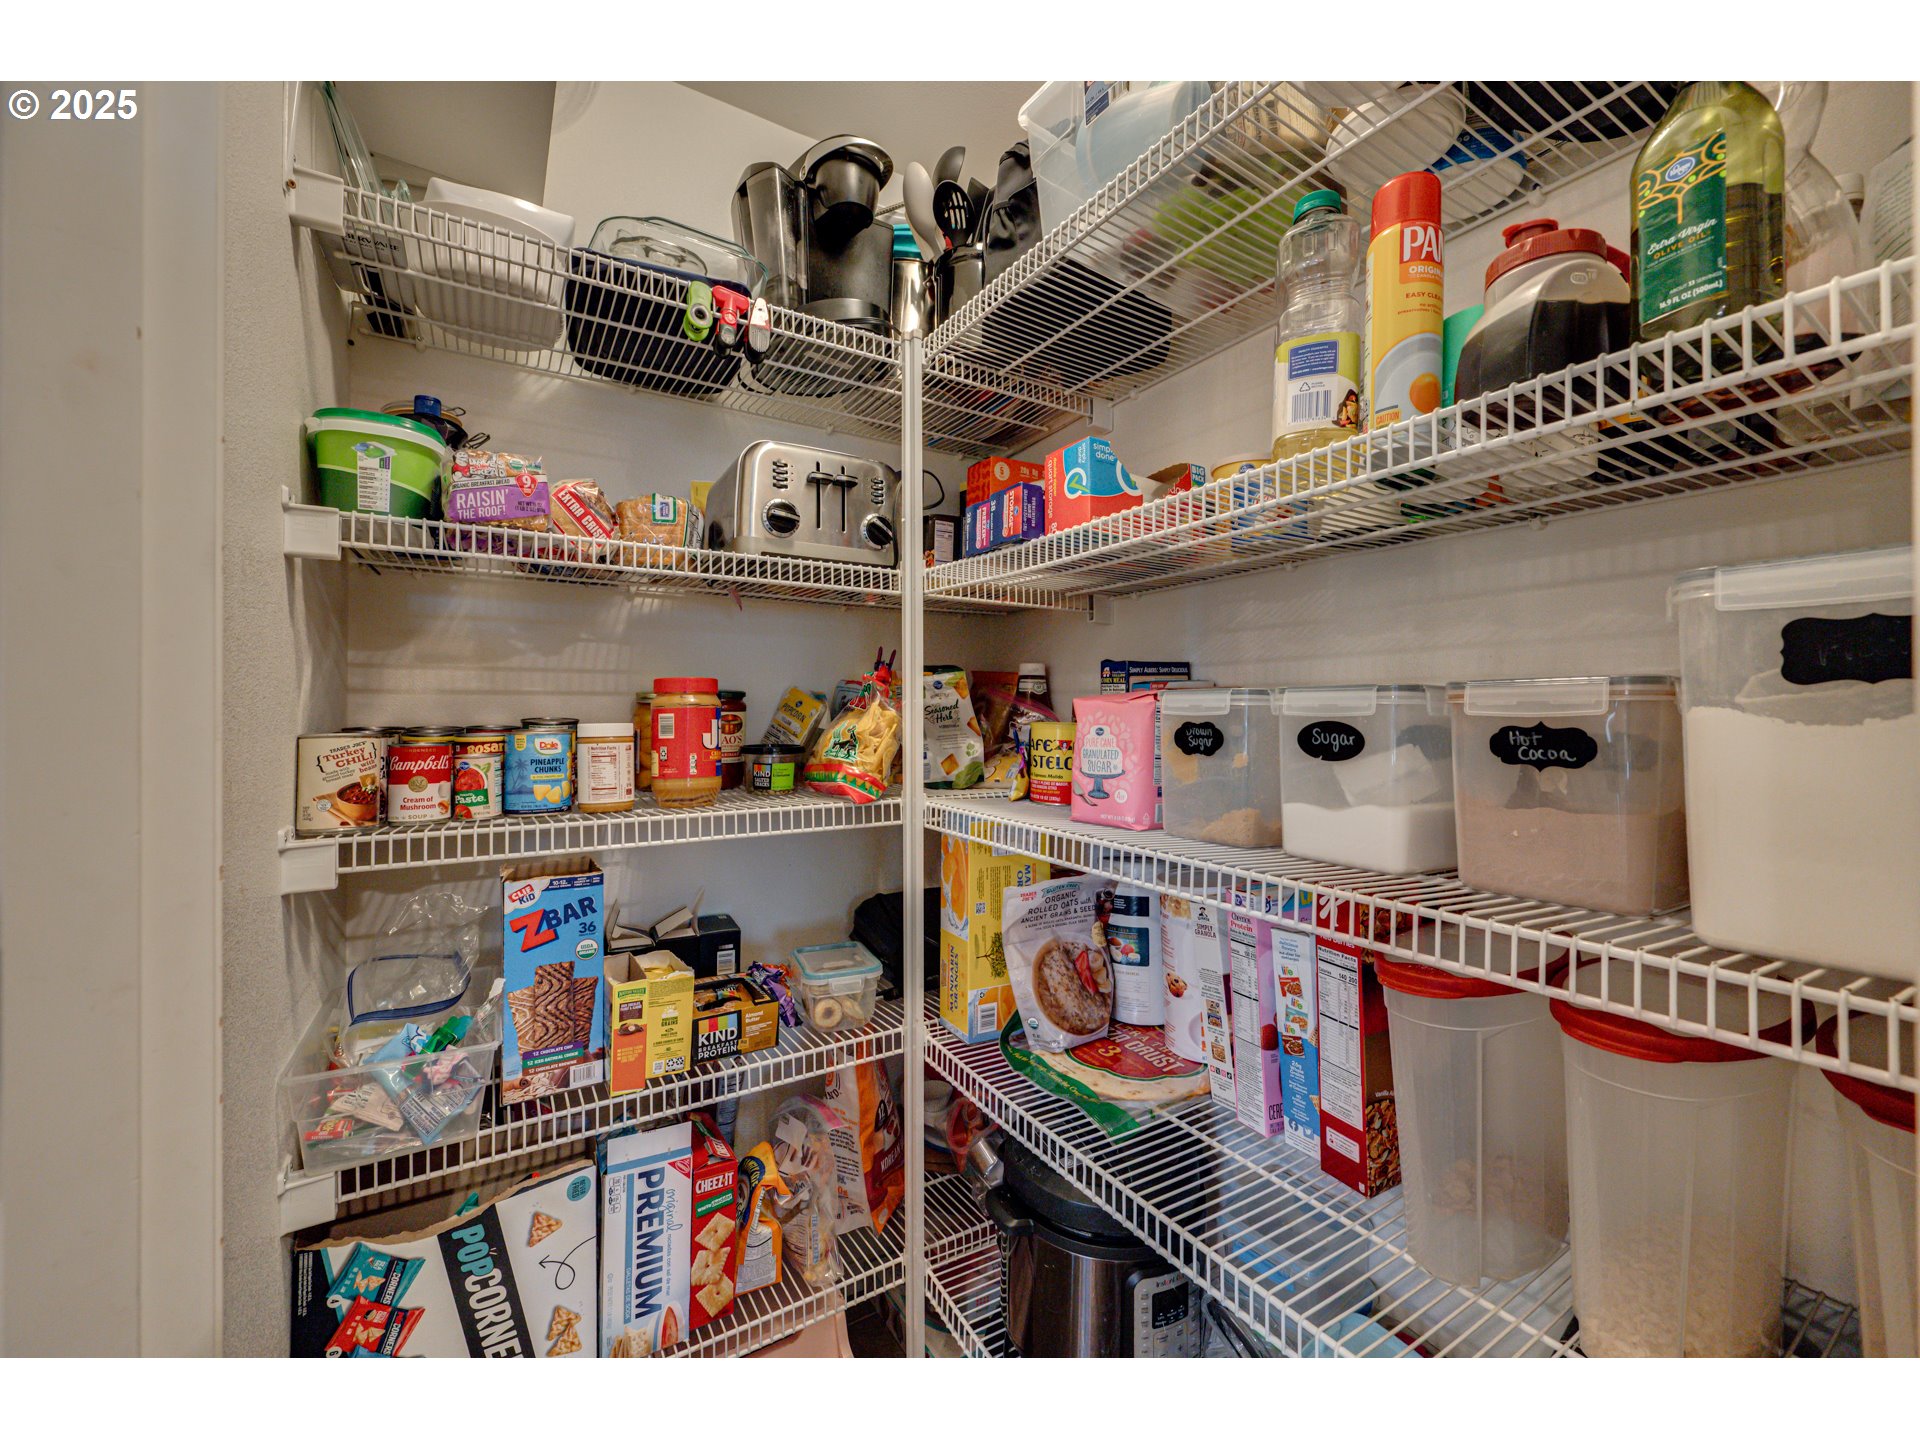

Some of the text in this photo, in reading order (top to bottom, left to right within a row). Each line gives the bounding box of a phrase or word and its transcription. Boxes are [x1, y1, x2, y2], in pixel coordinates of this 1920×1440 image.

[1647, 236, 1677, 255] Extra
[1677, 218, 1718, 239] Virgin
[1653, 241, 1684, 260] OLIVE
[1408, 265, 1443, 276] ORIGIN
[1405, 291, 1426, 299] EASY
[1672, 295, 1681, 304] FL
[1681, 290, 1692, 300] OZ
[1375, 410, 1400, 425] CAUTION
[1095, 451, 1115, 462] done
[1191, 464, 1205, 475] BIG
[470, 479, 495, 488] BREAKFAST
[495, 478, 511, 486] BREAD
[1191, 473, 1205, 483] PACK
[456, 488, 509, 510] RAISIN'
[557, 489, 585, 518] EXTRA
[457, 508, 476, 520] THE
[478, 504, 506, 518] ROOF!
[782, 702, 807, 723] POPCORN
[924, 698, 960, 716] Seasoned
[935, 711, 953, 724] Herb
[539, 741, 559, 749] Dole
[1085, 737, 1115, 748] PURE CANE
[1311, 727, 1356, 752] Sugar
[1508, 730, 1542, 746] Hot
[322, 747, 366, 762] Turkey
[335, 752, 373, 768] CHILI
[1083, 748, 1119, 760] GRANULATED
[1517, 746, 1577, 762] Cocoa
[358, 764, 377, 773] beans
[360, 759, 375, 768] with
[389, 755, 449, 774] Campbell's
[530, 757, 565, 766] PINEAPPLE
[1087, 760, 1112, 773] SUGAR
[534, 765, 562, 773] CHUNKS
[400, 803, 437, 811] Mushroom
[511, 885, 532, 900] CLIF
[1046, 884, 1065, 894] GLUTEN
[1044, 890, 1077, 904] ORGANIC
[1027, 903, 1058, 915] ROLLED
[1060, 898, 1079, 909] OATS
[1020, 913, 1047, 924] ANCIENT
[1049, 908, 1072, 919] GRAINS
[578, 921, 597, 934] 36
[1194, 928, 1217, 939] GRANOLA
[1196, 922, 1213, 931] SIMPLY
[1230, 921, 1253, 933] Protein
[1318, 946, 1357, 963] Nutrition Facts
[1281, 964, 1294, 976] life
[1290, 996, 1303, 1010] life
[745, 1010, 764, 1019] Almond
[1283, 1023, 1296, 1035] life
[698, 1027, 738, 1047] KIND
[540, 1046, 564, 1055] CHOCOLATE
[697, 1040, 738, 1053] BREAKFAST
[697, 1045, 737, 1060] PROTEIN
[1098, 1045, 1121, 1058] 3
[1124, 1041, 1186, 1073] CRUST
[535, 1064, 558, 1072] CHOCOLATE
[571, 1181, 581, 1199] FRIED
[695, 1171, 734, 1195] CHEEZ-IT
[696, 1193, 733, 1213] WHITE cheddar
[660, 1188, 684, 1236] original
[634, 1166, 666, 1320] PREMIUM
